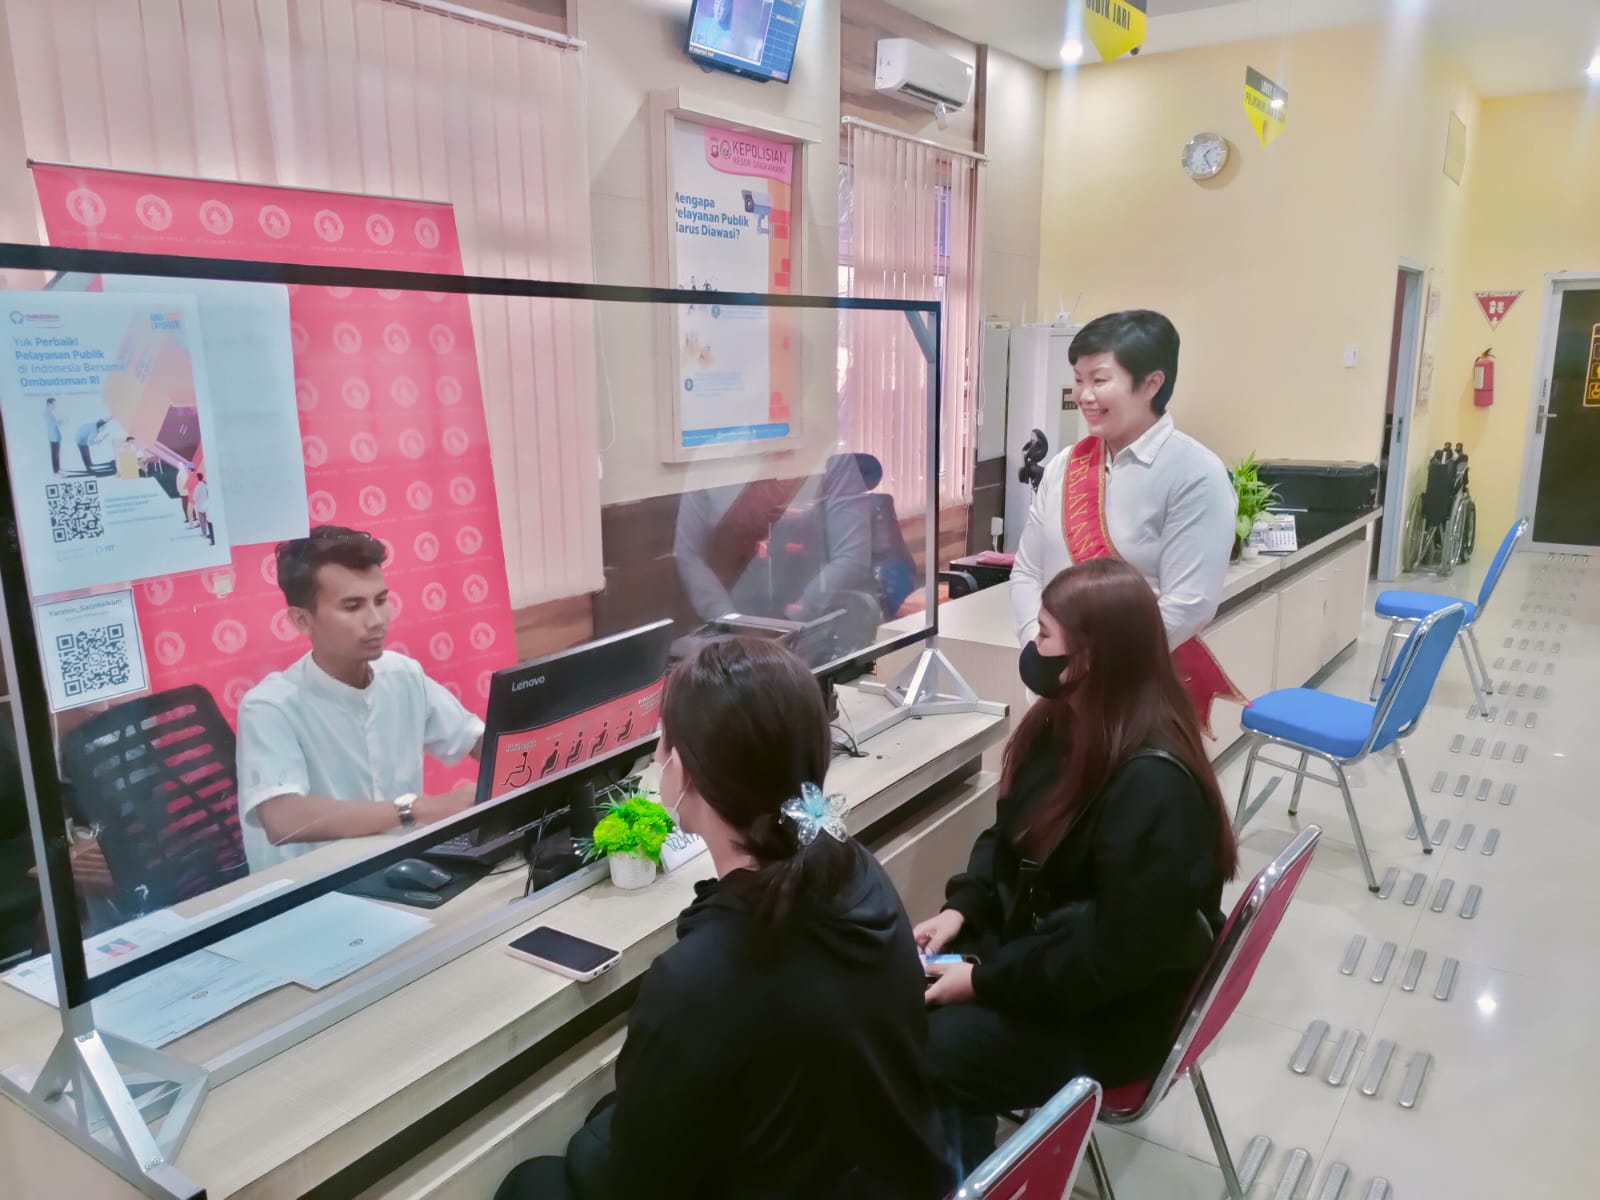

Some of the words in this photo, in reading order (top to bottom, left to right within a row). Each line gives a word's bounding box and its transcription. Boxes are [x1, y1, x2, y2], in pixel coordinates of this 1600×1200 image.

[732, 140, 787, 165] KEPOLISIAN
[675, 206, 720, 224] elayanan
[721, 212, 749, 228] Publik
[701, 224, 740, 239] Diawasi?
[14, 336, 32, 347] Yuk
[35, 337, 79, 346] Perbaiki
[15, 350, 71, 361] Pelayanan
[72, 349, 105, 359] Publik
[17, 363, 28, 374] di
[31, 363, 81, 374] Indonesia
[20, 376, 87, 387] Ombudsman
[89, 375, 101, 385] RI
[511, 675, 546, 692] Lenovo
